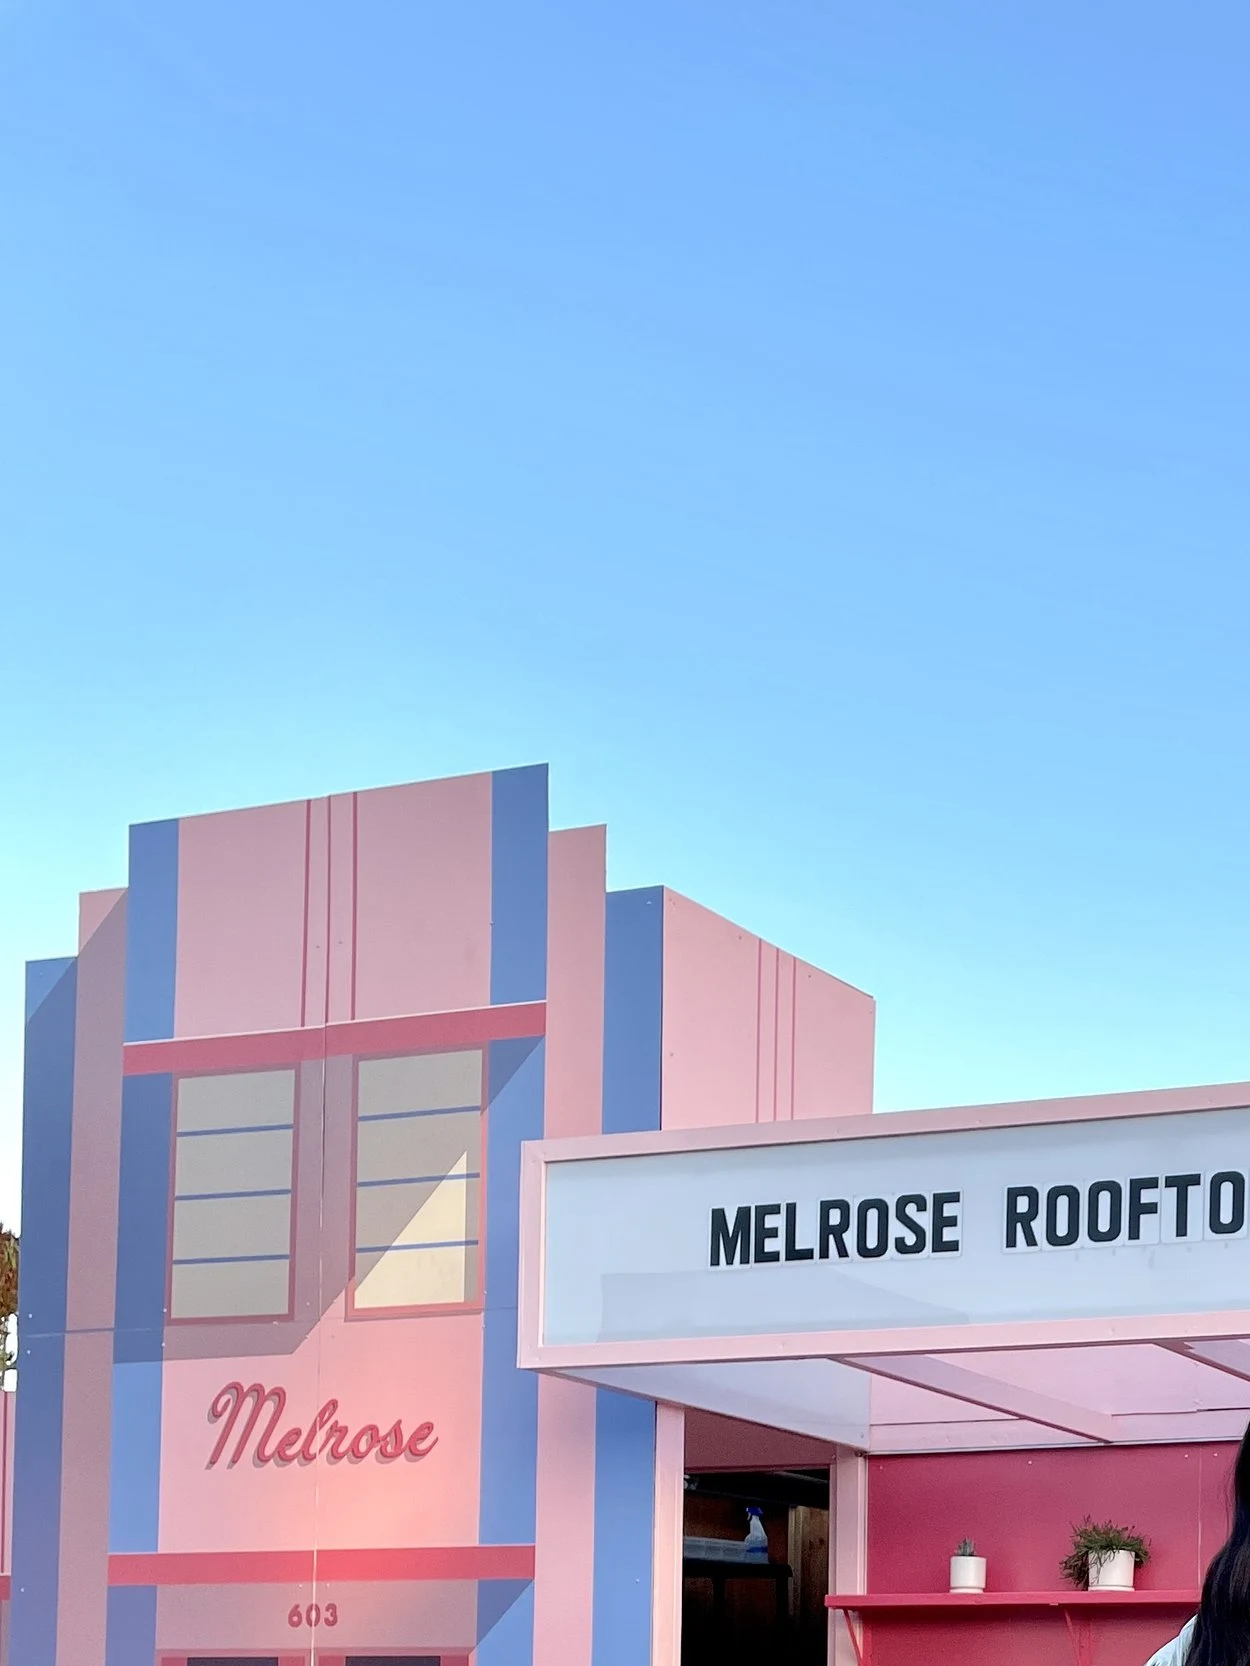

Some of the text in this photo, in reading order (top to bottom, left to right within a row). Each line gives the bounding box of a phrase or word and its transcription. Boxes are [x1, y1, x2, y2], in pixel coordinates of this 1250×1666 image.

[709, 1191, 961, 1267] MELROSE
[205, 1381, 439, 1470] Melrose
[287, 1602, 339, 1628] 603
